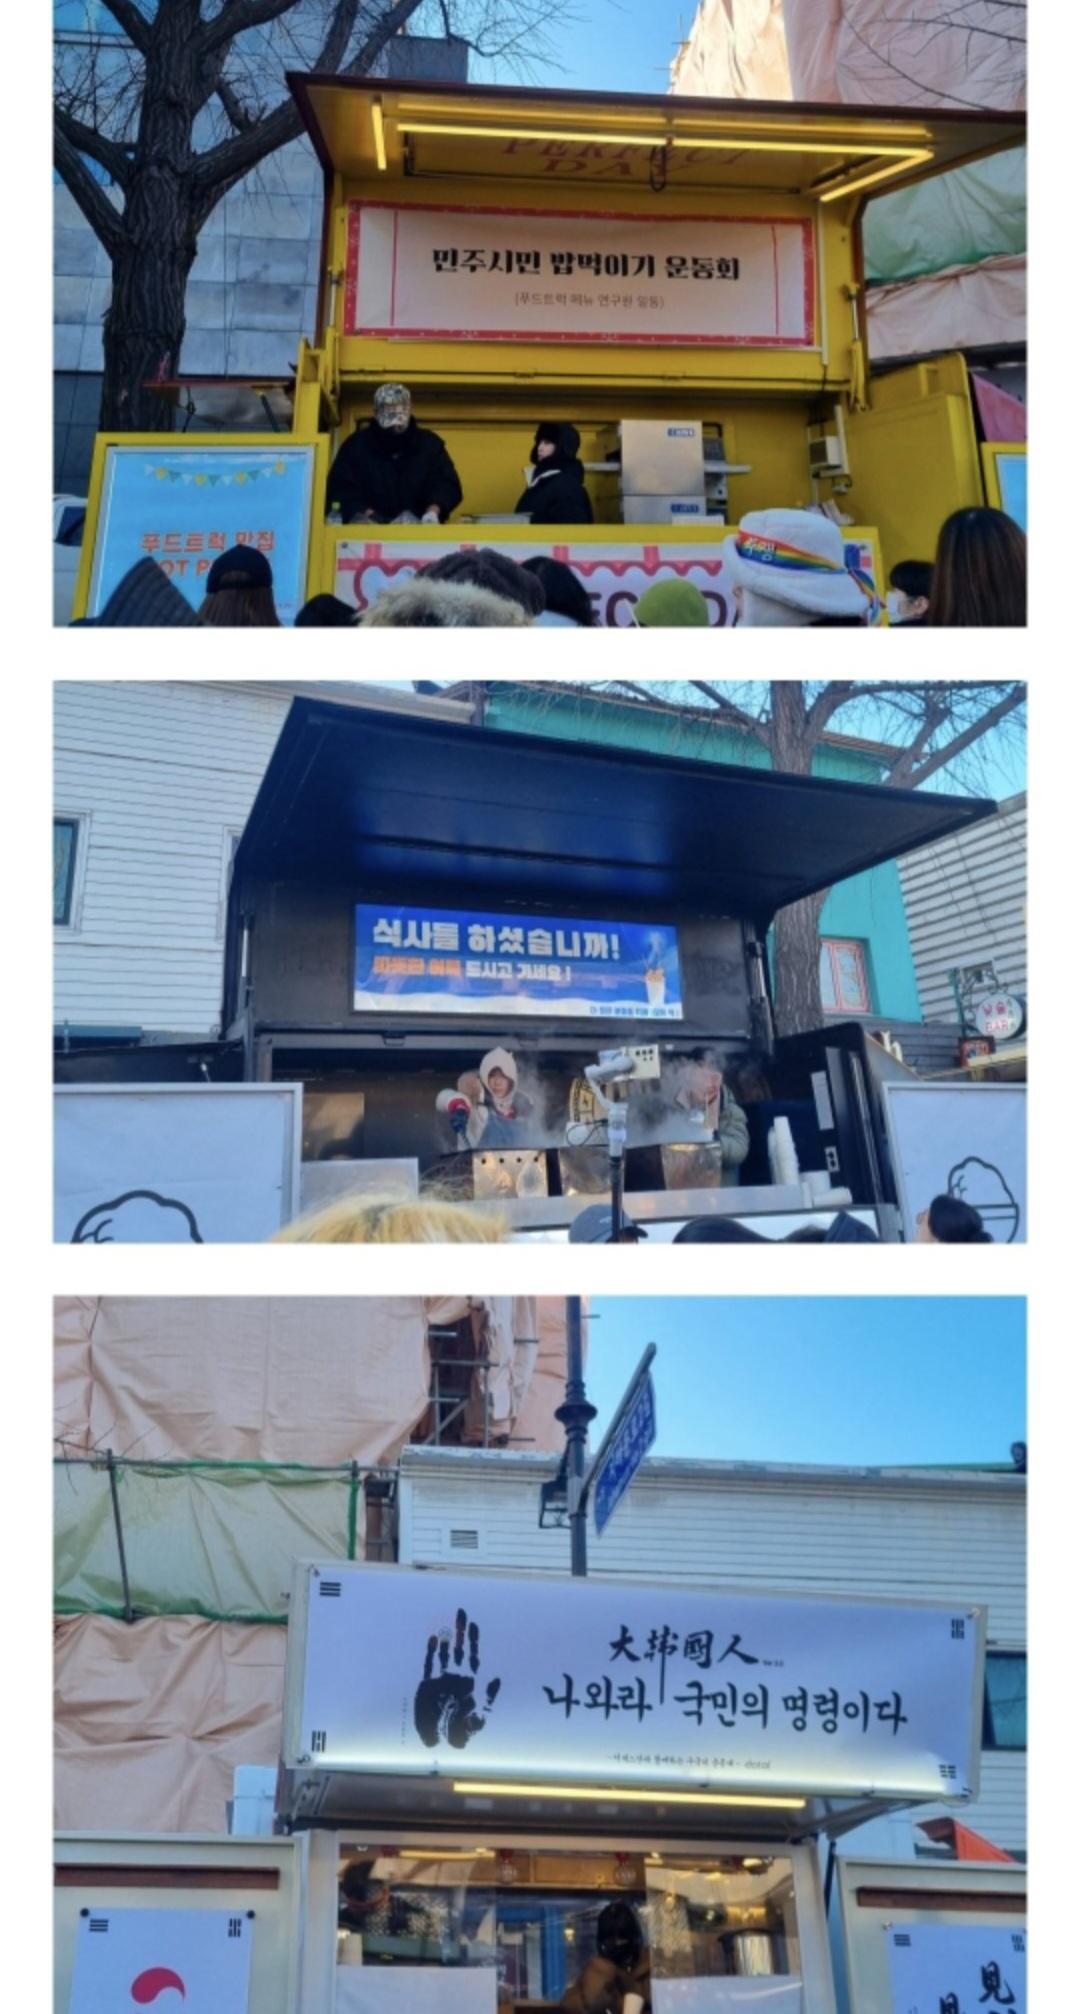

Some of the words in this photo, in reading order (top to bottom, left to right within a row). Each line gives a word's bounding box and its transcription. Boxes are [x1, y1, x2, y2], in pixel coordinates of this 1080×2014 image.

[432, 248, 541, 275] 민주시민
[550, 251, 656, 278] 밥먹이기
[664, 255, 740, 281] 운동회
[141, 531, 226, 554] 푸드트럭
[465, 960, 513, 979] 드시고
[542, 1673, 653, 1722] 나와라
[673, 1680, 769, 1730] 국민의
[781, 1686, 908, 1736] 명령이다
